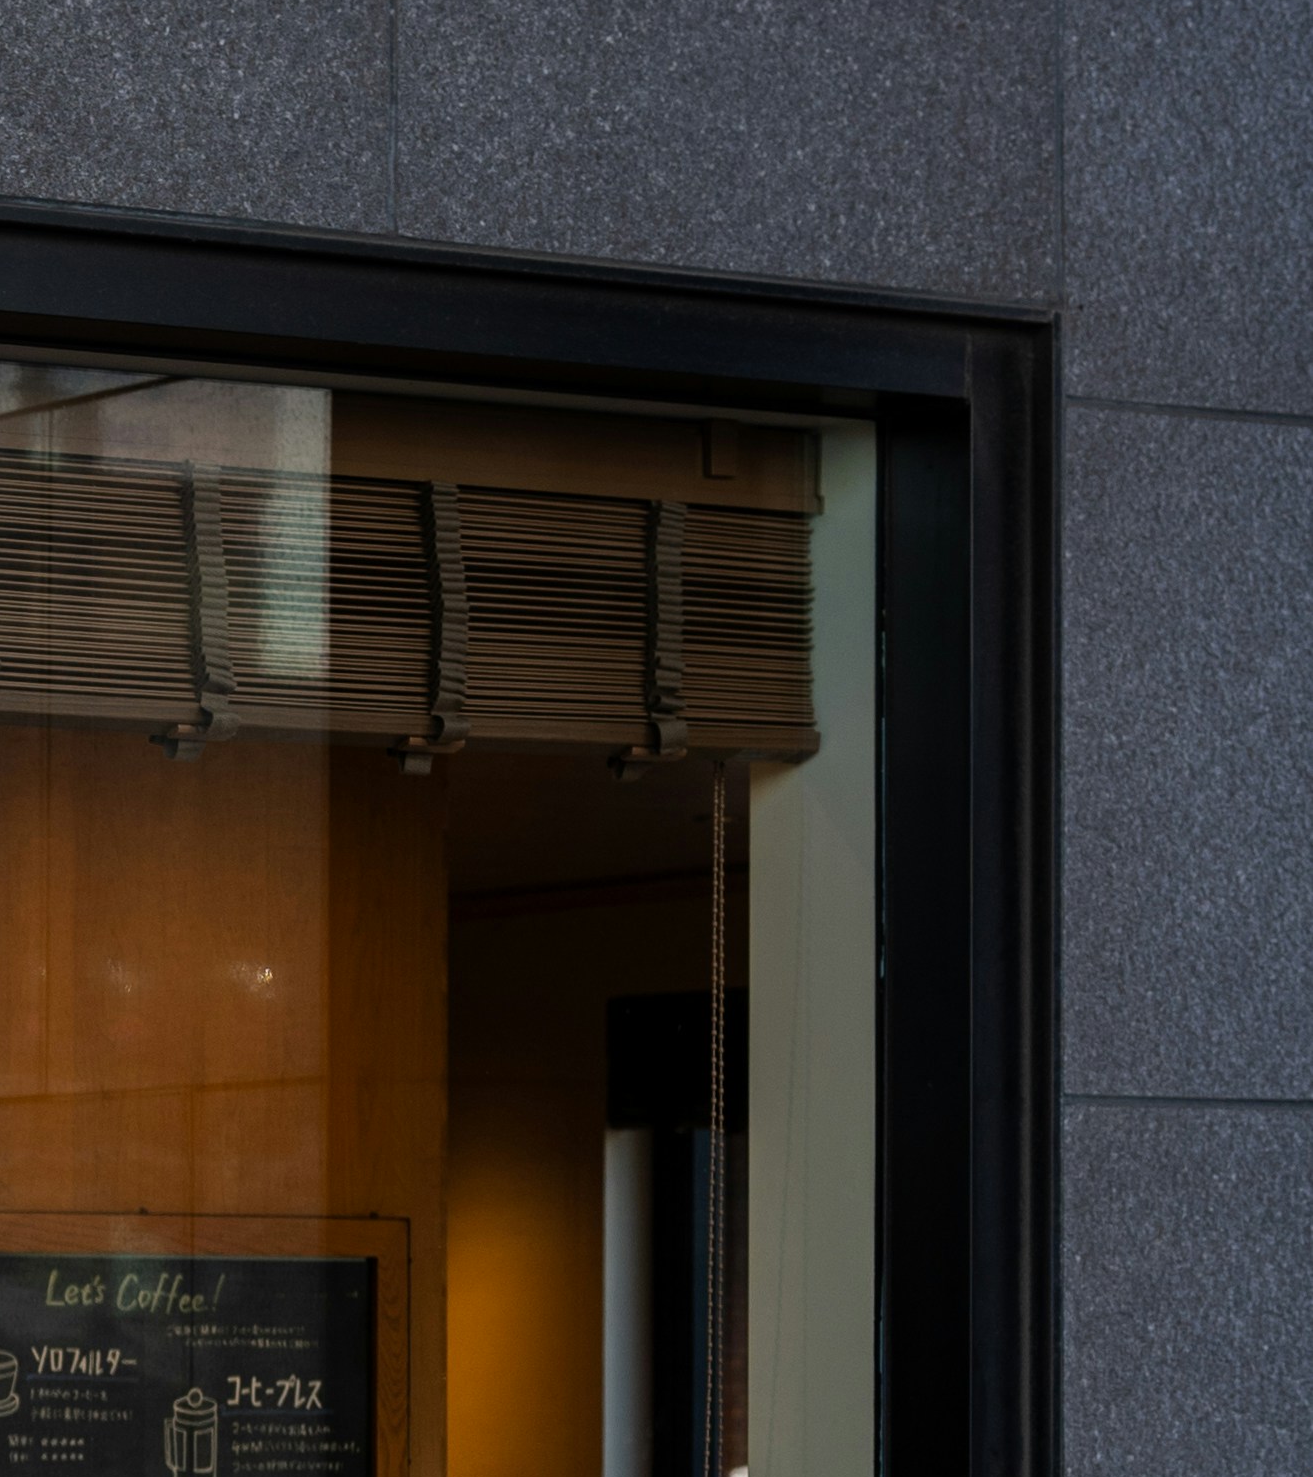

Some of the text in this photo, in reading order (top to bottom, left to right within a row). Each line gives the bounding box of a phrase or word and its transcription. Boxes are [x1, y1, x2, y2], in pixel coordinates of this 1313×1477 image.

[45, 1269, 226, 1314] Let's Coffee!
[226, 1374, 323, 1409] コーヒープレス
